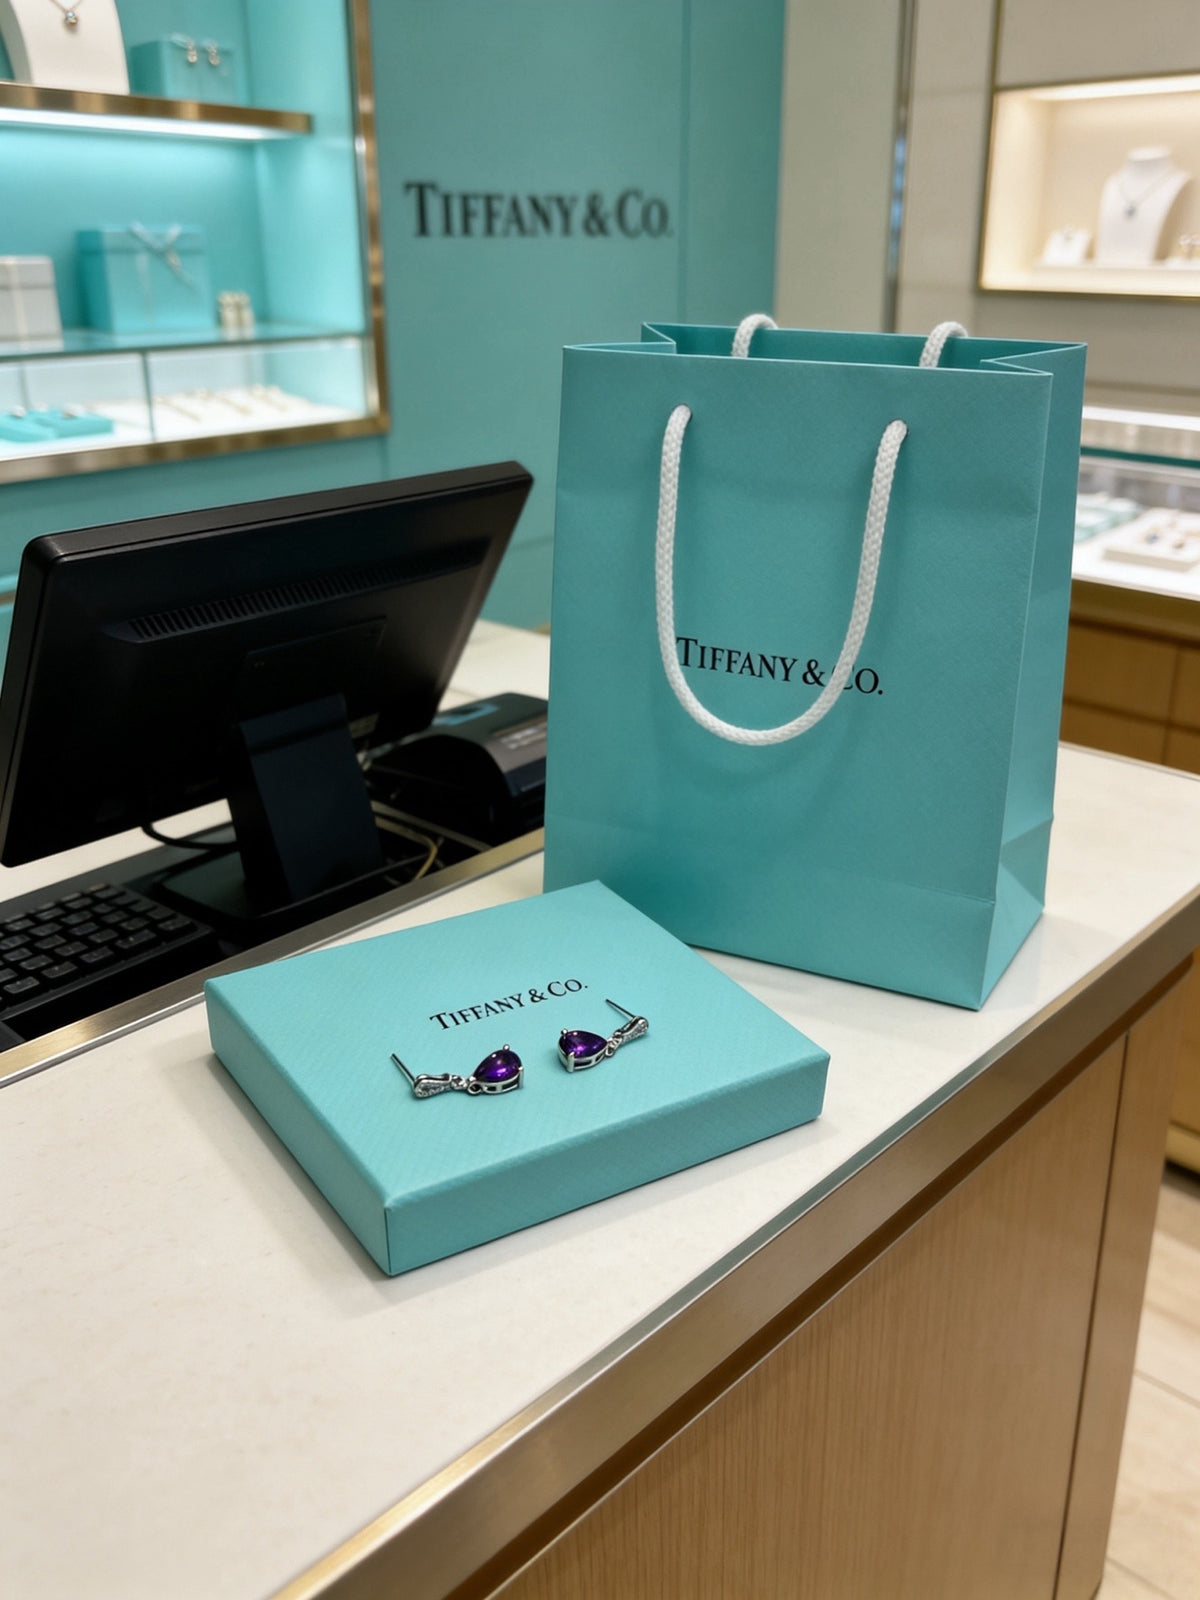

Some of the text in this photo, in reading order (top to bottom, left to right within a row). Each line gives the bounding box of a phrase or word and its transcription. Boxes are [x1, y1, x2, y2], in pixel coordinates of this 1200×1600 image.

[404, 181, 578, 237] TIFFANY
[676, 636, 798, 682] TIFFANY
[802, 659, 826, 687] &
[429, 993, 525, 1030] TIFFANY
[528, 988, 548, 1004] &
